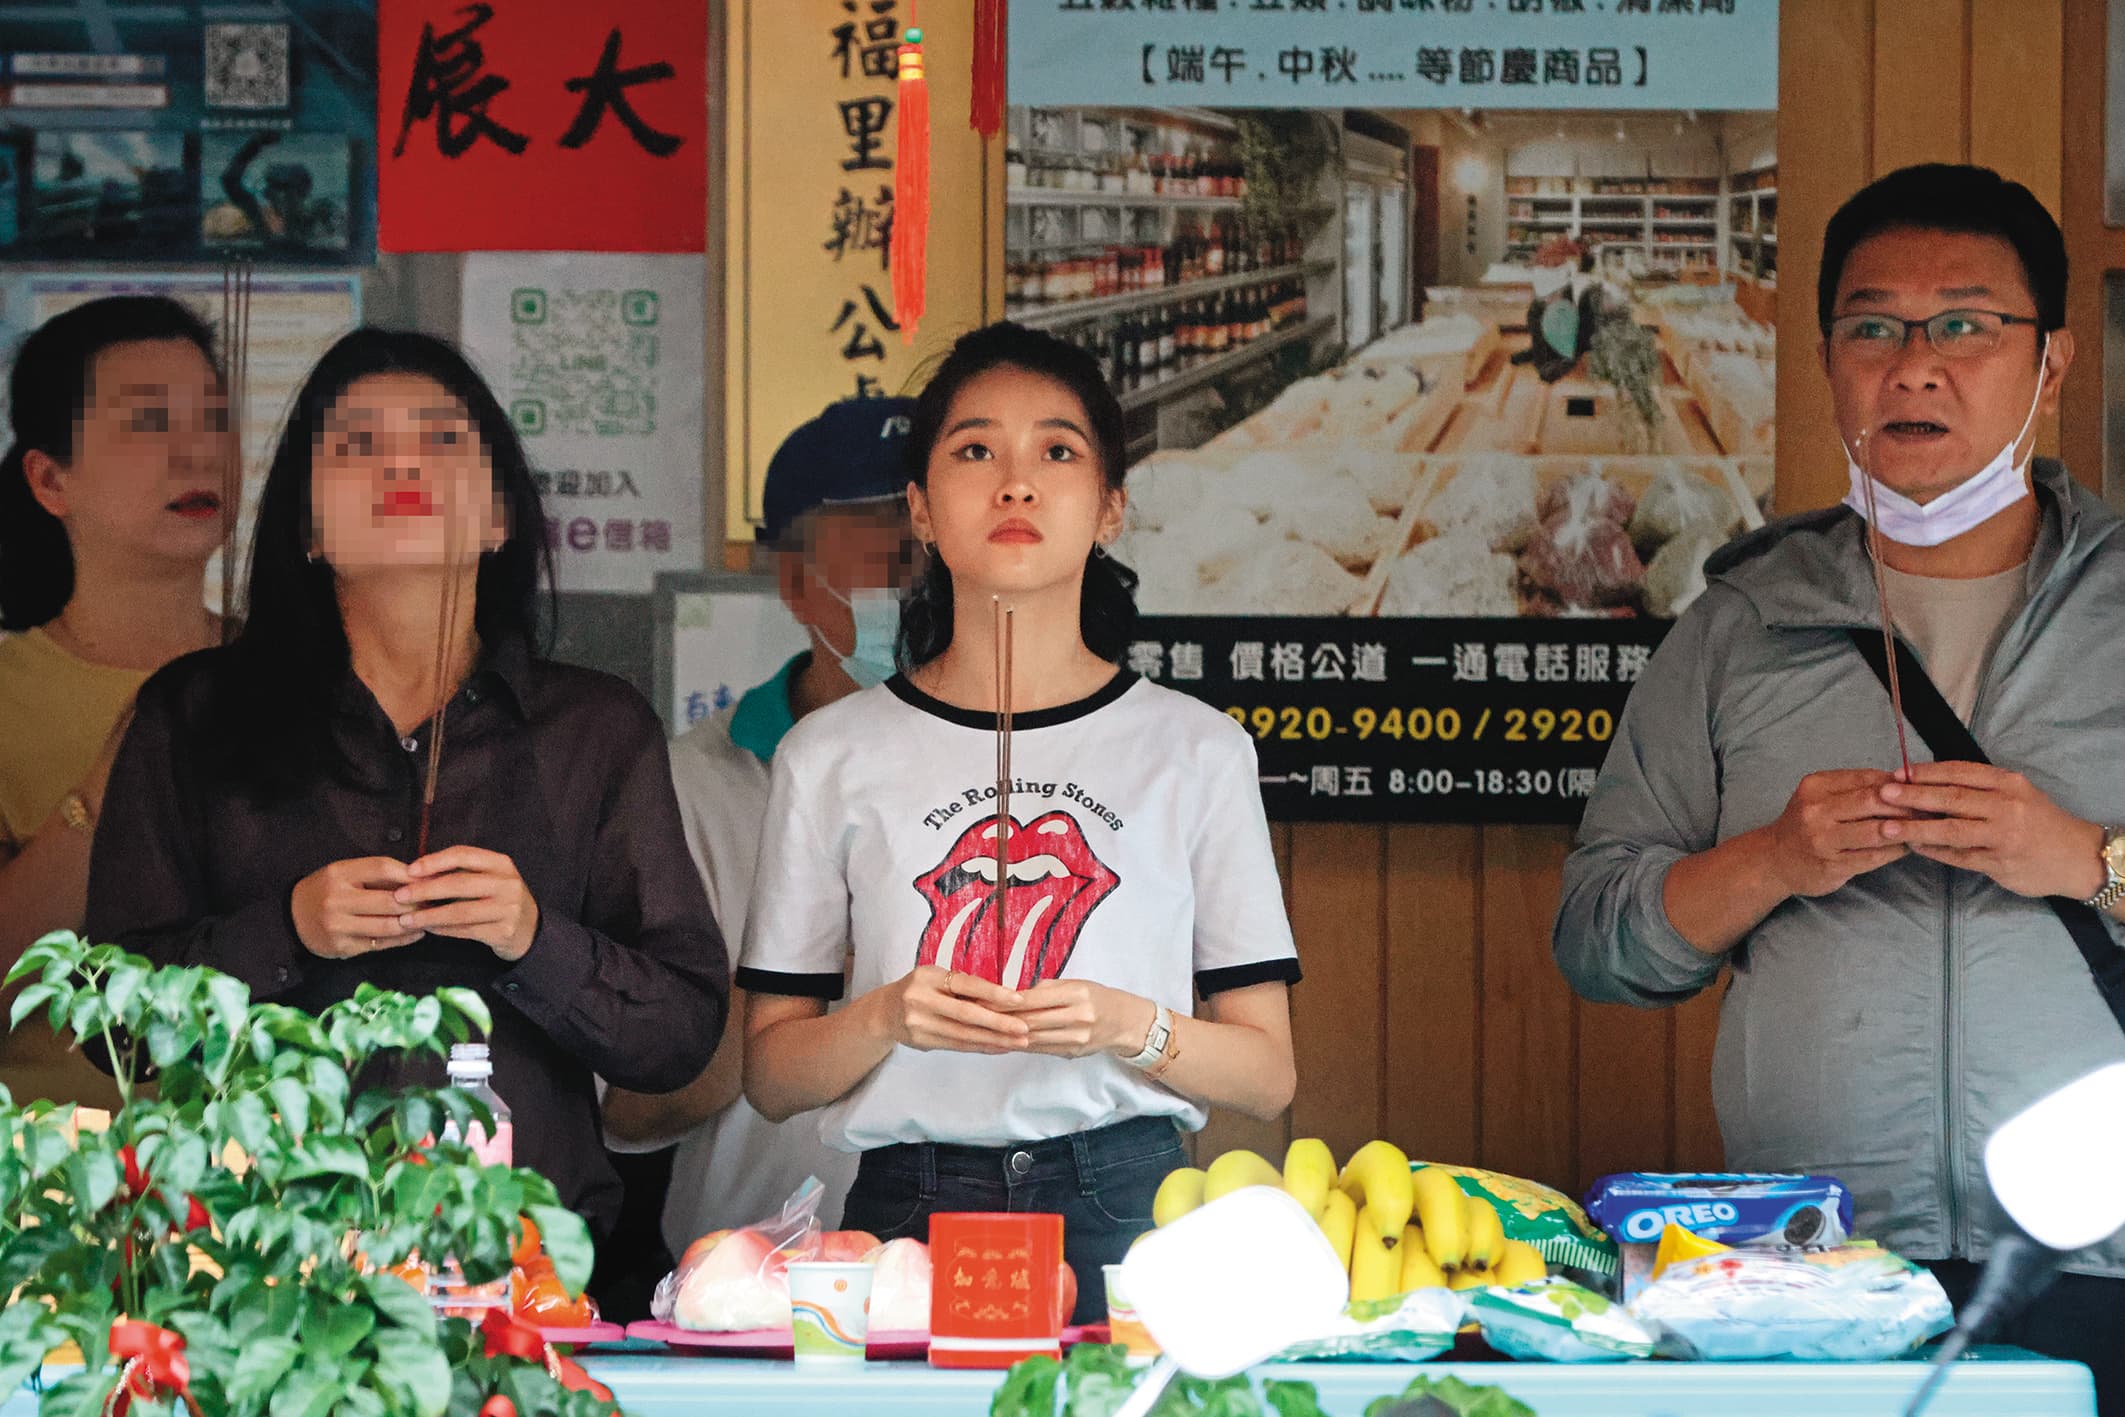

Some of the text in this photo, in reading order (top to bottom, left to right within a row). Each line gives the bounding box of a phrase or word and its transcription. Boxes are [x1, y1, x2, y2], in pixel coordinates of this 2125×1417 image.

[1128, 640, 1652, 683] 零售 價格公道 一通電話服務
[1504, 708, 1613, 742] 2920
[923, 801, 963, 831] The
[1062, 781, 1125, 832] Stones
[1626, 1202, 1737, 1239] OREO
